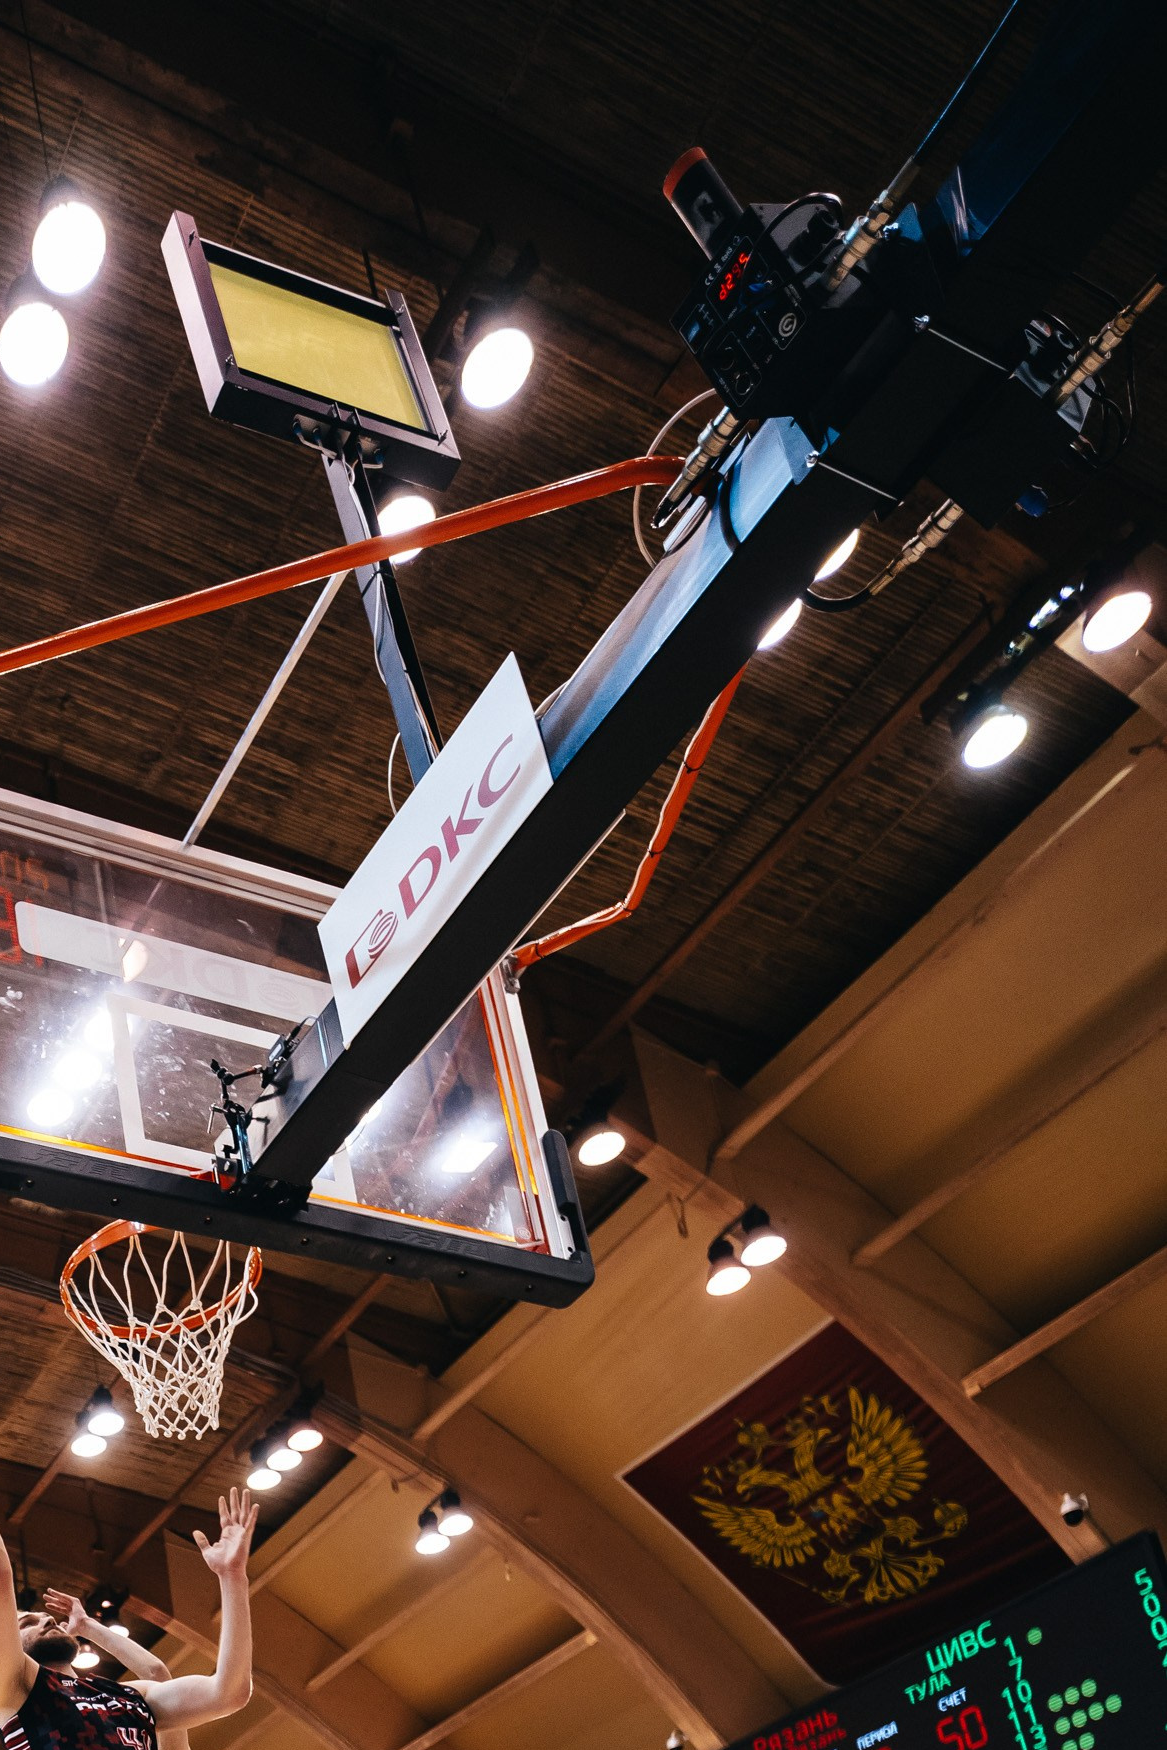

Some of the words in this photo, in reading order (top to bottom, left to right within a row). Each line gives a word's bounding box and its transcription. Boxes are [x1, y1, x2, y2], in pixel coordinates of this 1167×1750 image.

[398, 733, 521, 920] DKC
[1134, 1567, 1153, 1596] 5
[1143, 1592, 1161, 1618] 0
[1150, 1615, 1167, 1641] 0
[926, 1619, 997, 1674] ЦИВС
[1003, 1635, 1016, 1659] 1
[1008, 1656, 1022, 1681] 7
[904, 1670, 951, 1704] ТУЛА
[937, 1686, 967, 1712] СЧЕТ
[1001, 1679, 1032, 1709] 10
[1008, 1702, 1037, 1732] 11
[856, 1720, 898, 1750] ПЕРИОД
